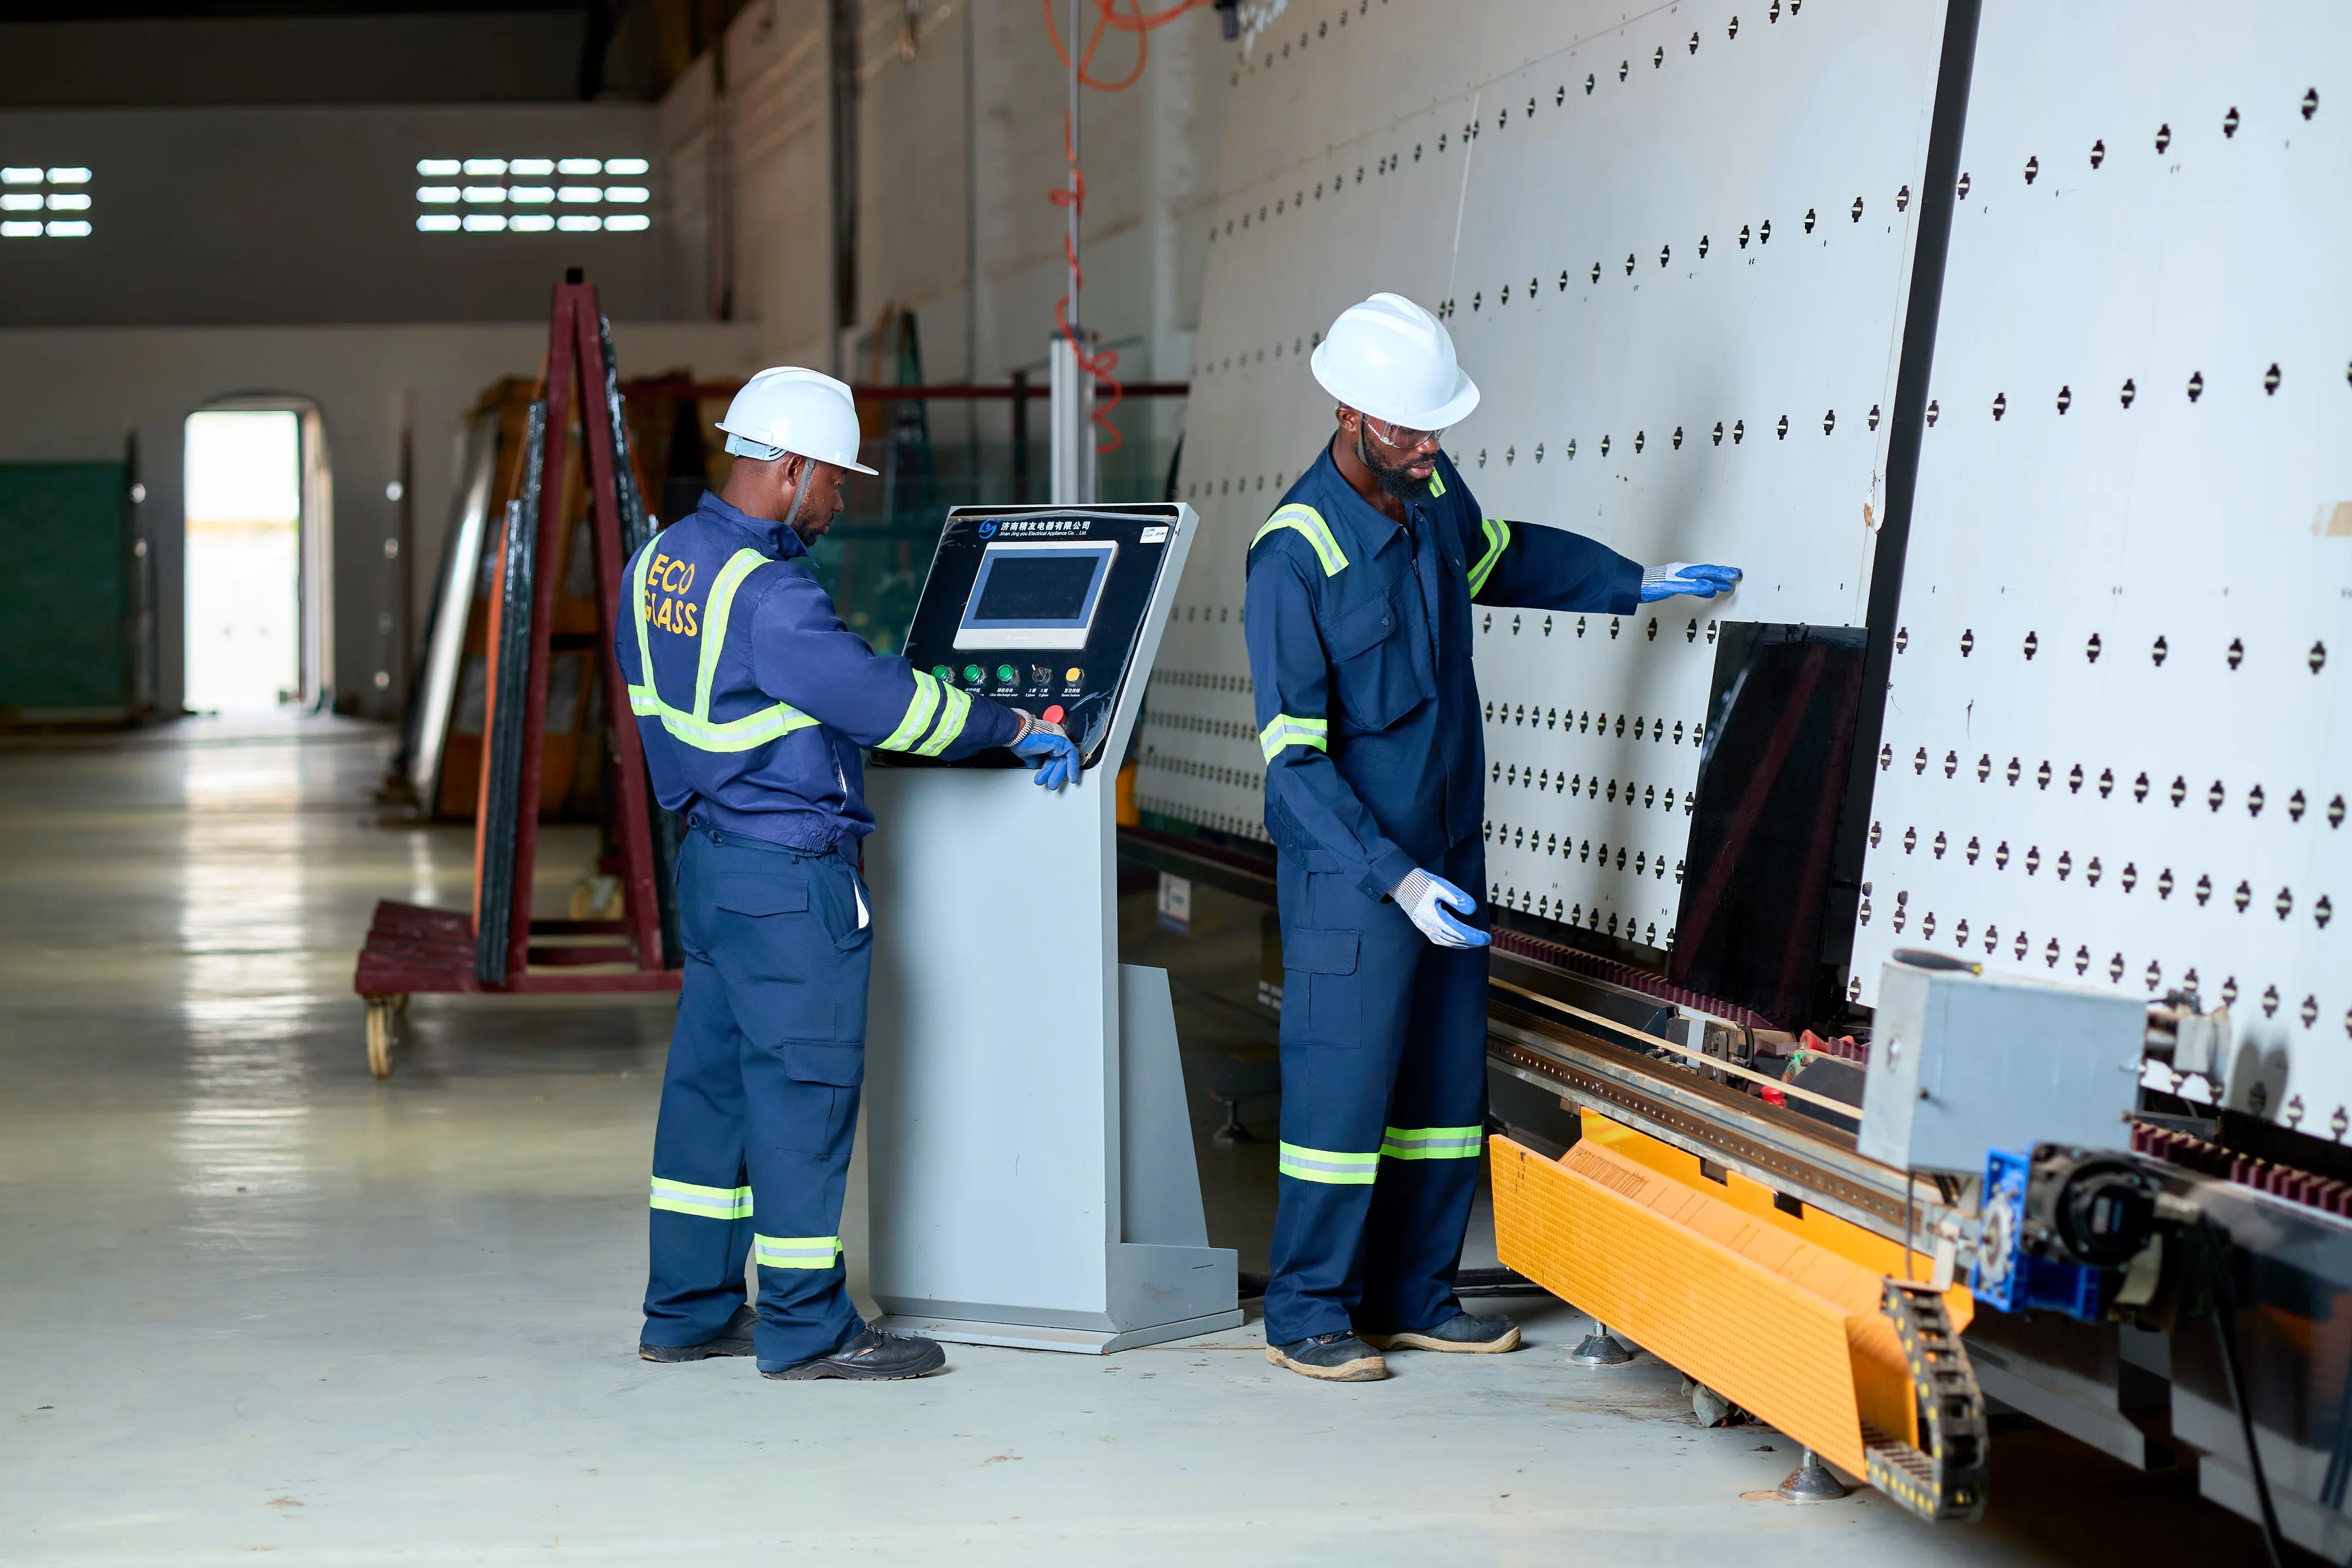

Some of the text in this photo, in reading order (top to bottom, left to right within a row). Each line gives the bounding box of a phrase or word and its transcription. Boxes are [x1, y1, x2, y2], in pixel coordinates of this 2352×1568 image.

[1000, 521, 1090, 531] 济南精友电器有限公司
[647, 554, 695, 595] ECO
[644, 589, 698, 637] GLASS
